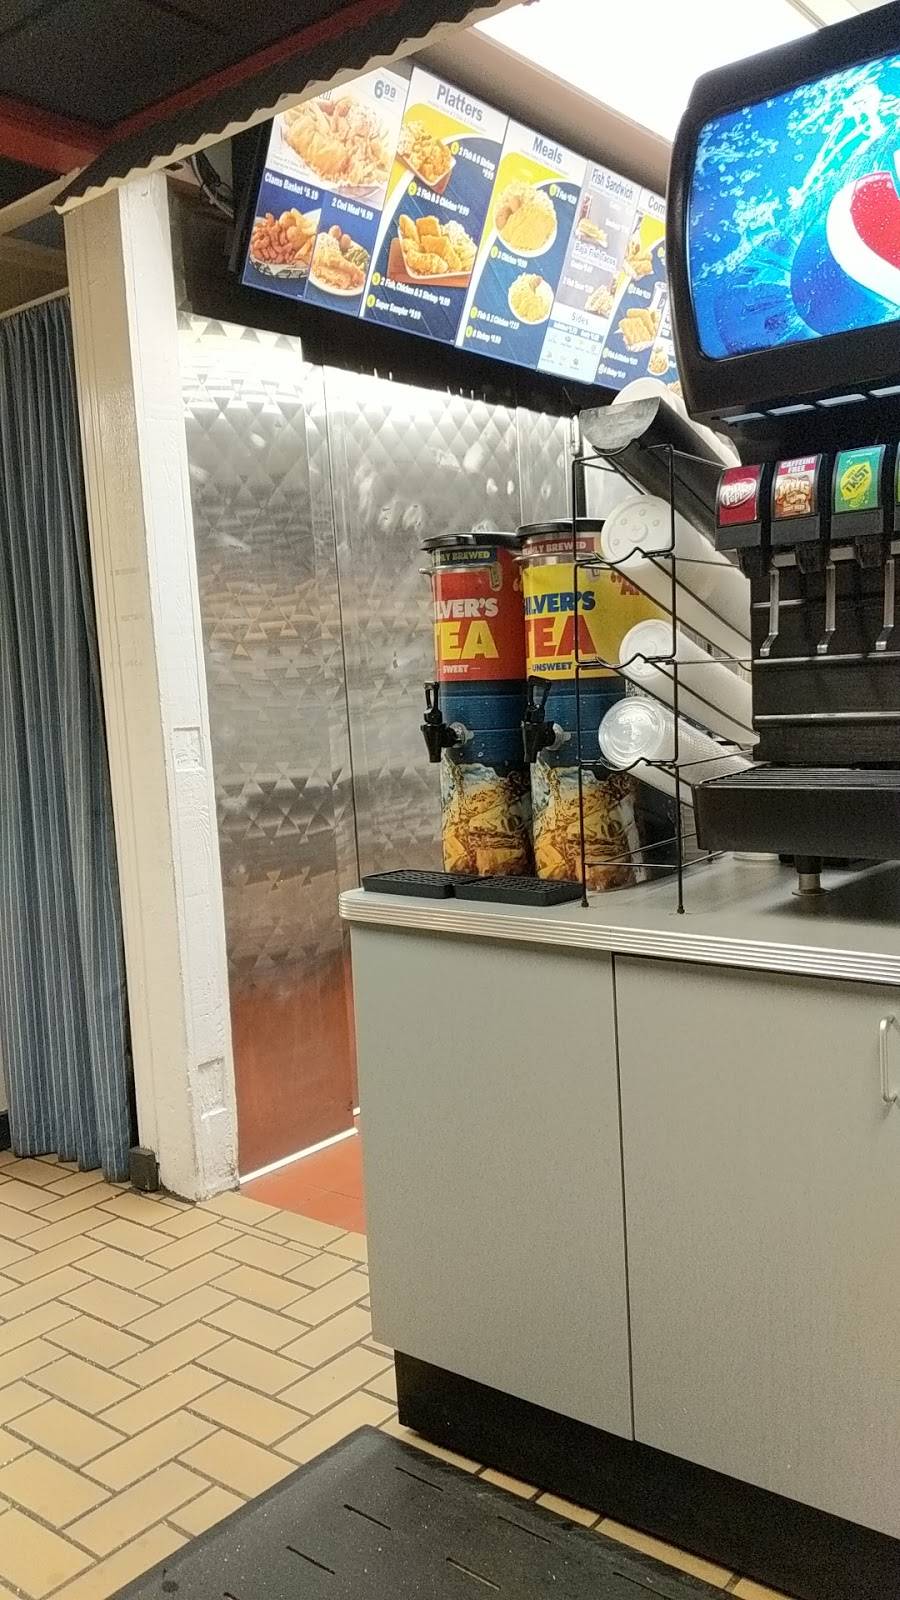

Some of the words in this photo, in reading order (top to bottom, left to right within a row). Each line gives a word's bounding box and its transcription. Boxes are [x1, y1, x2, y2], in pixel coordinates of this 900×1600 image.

[437, 84, 483, 121] Platters
[532, 137, 563, 164] Meals
[264, 172, 283, 188] Clams
[283, 179, 303, 195] Basket
[592, 168, 605, 186] Fish
[605, 175, 633, 200] Sandwich
[452, 551, 490, 560] BREWED
